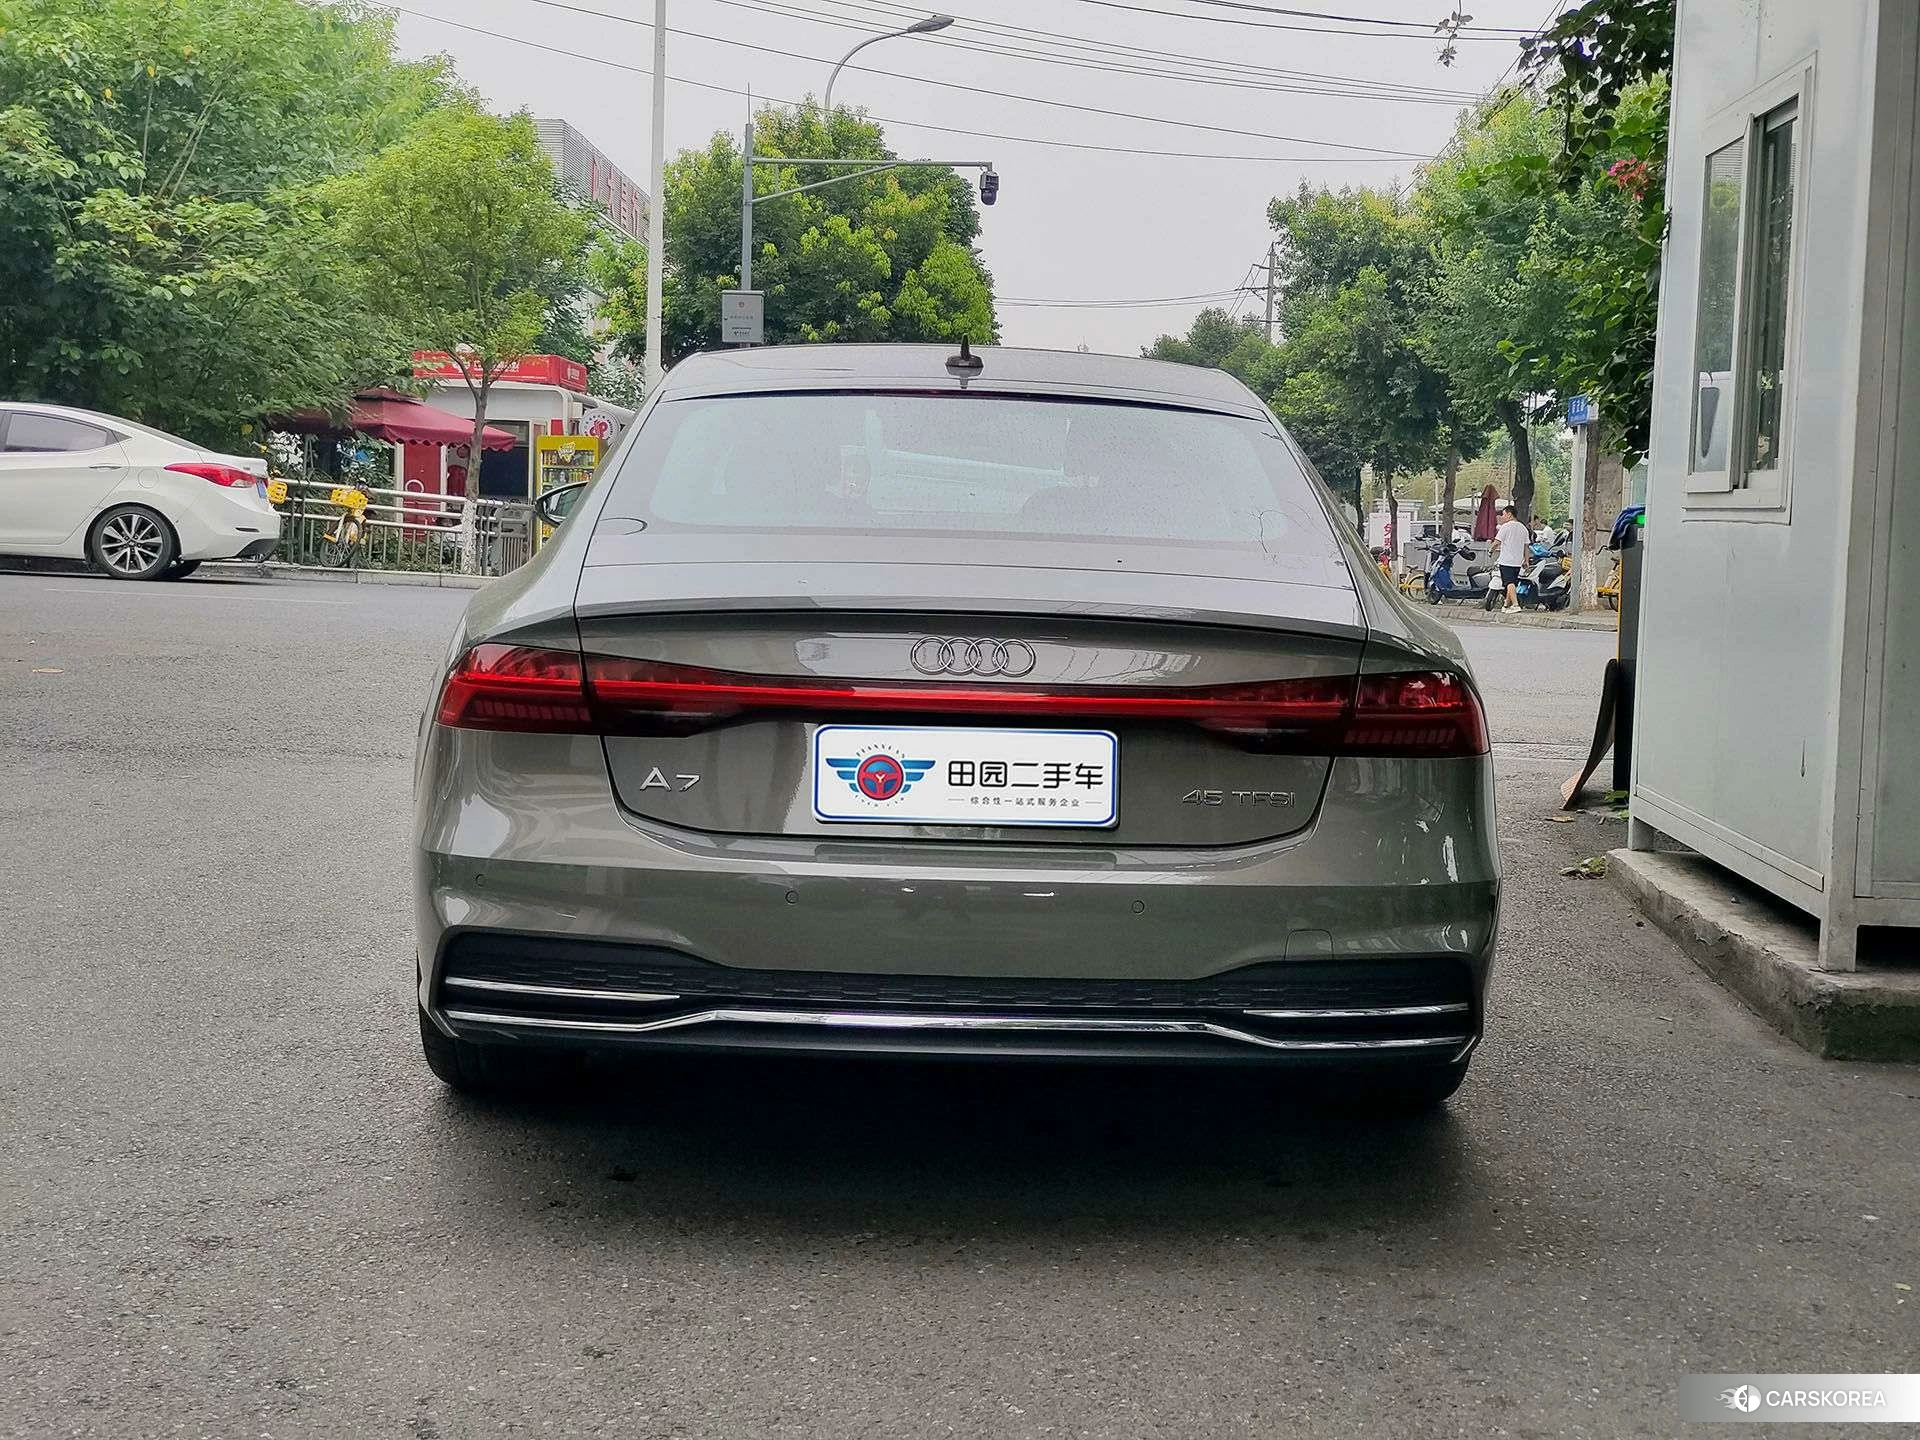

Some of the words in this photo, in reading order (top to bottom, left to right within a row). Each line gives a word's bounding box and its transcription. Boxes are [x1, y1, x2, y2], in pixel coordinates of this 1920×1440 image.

[639, 766, 701, 792] A7
[948, 760, 1104, 790] 田园二手车
[1182, 788, 1225, 807] 45
[1231, 790, 1296, 808] TFSI
